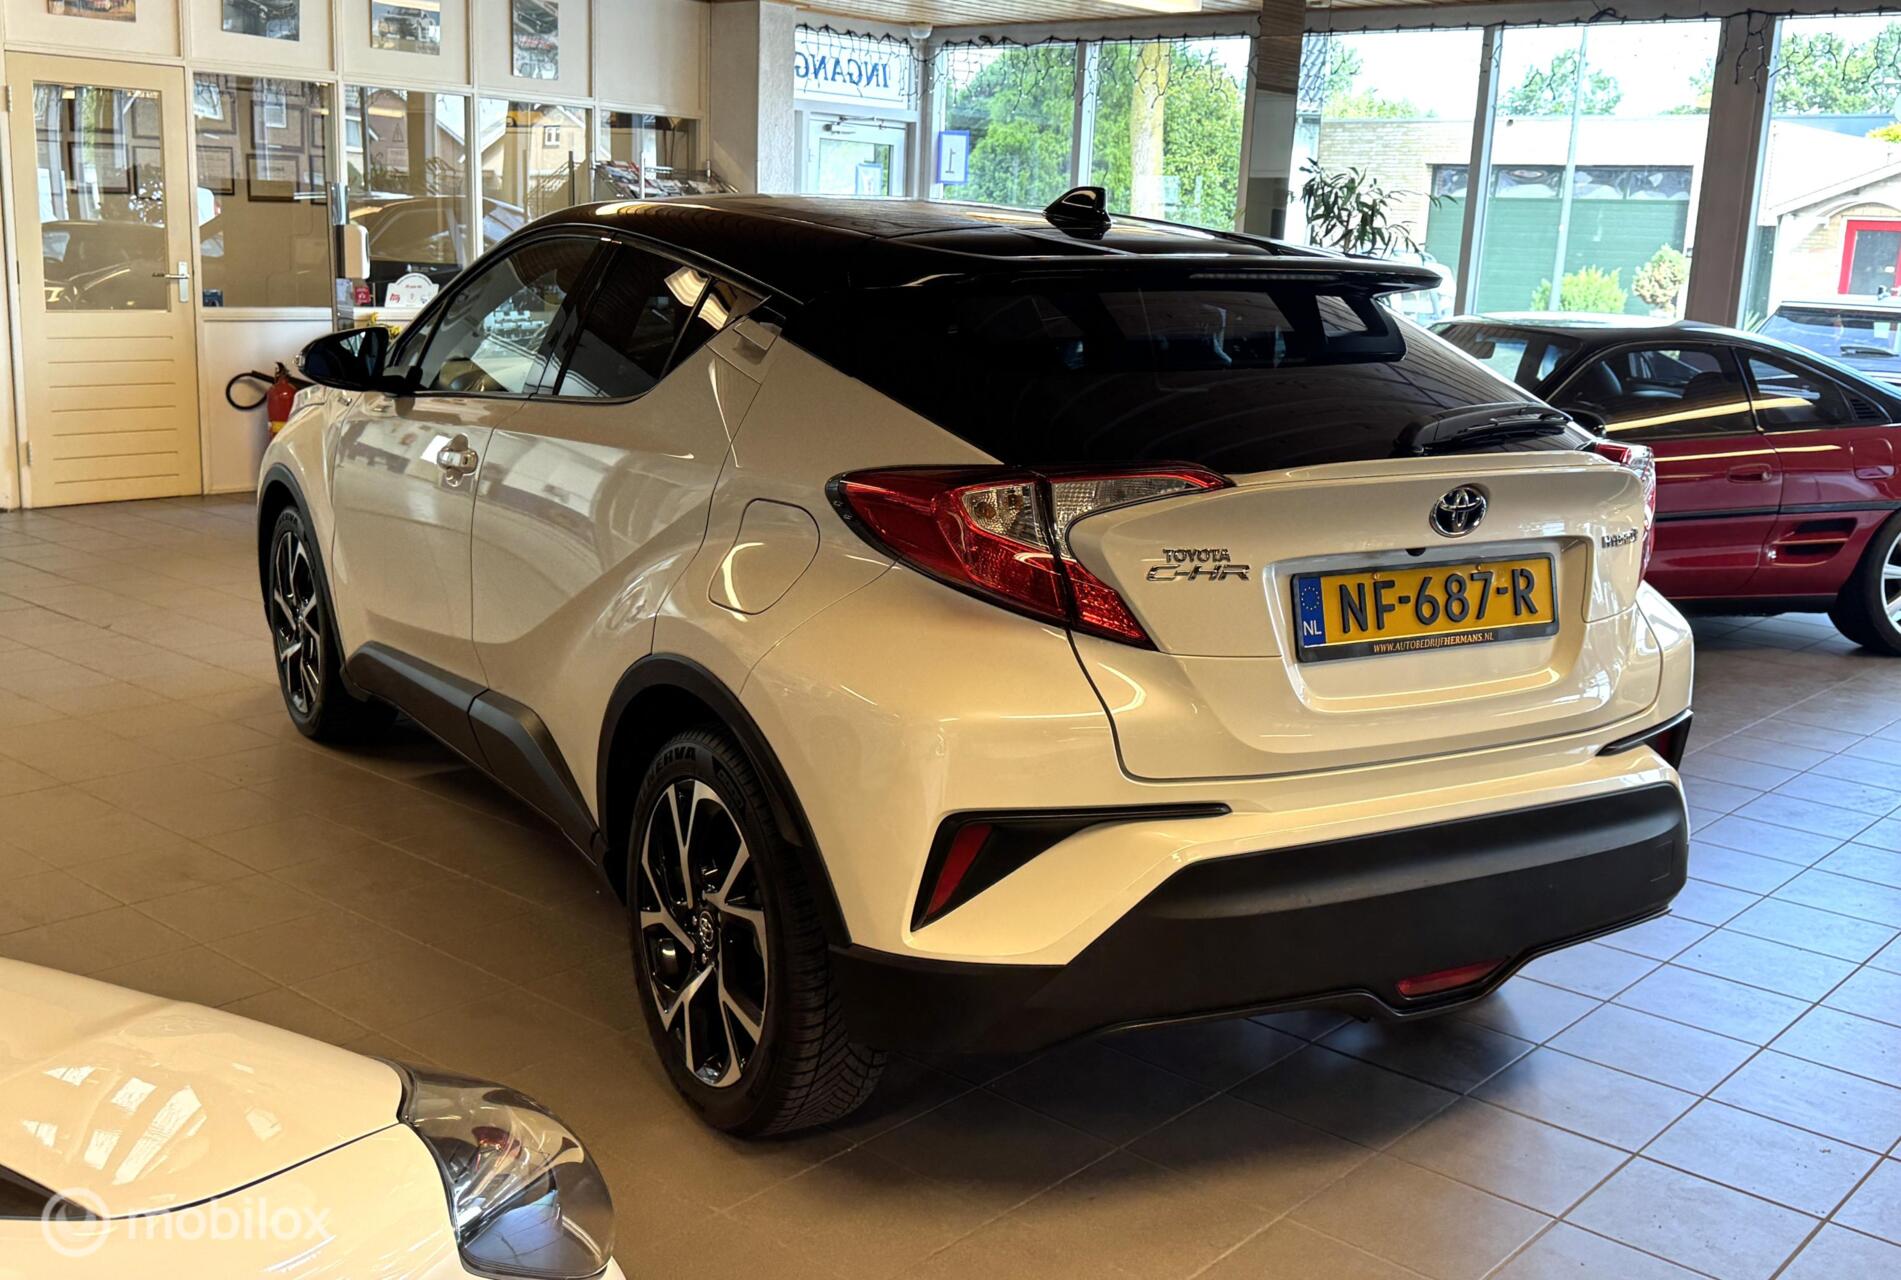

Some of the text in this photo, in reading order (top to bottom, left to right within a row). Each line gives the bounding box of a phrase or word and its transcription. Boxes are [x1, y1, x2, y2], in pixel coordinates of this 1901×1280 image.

[1163, 548, 1231, 563] TOYOTA
[1146, 564, 1250, 581] C-HR
[1339, 568, 1538, 634] NF-687-R
[1303, 620, 1322, 636] NL
[1373, 632, 1495, 653] WWW.AUTOBEDRIJFHERMANS.NL
